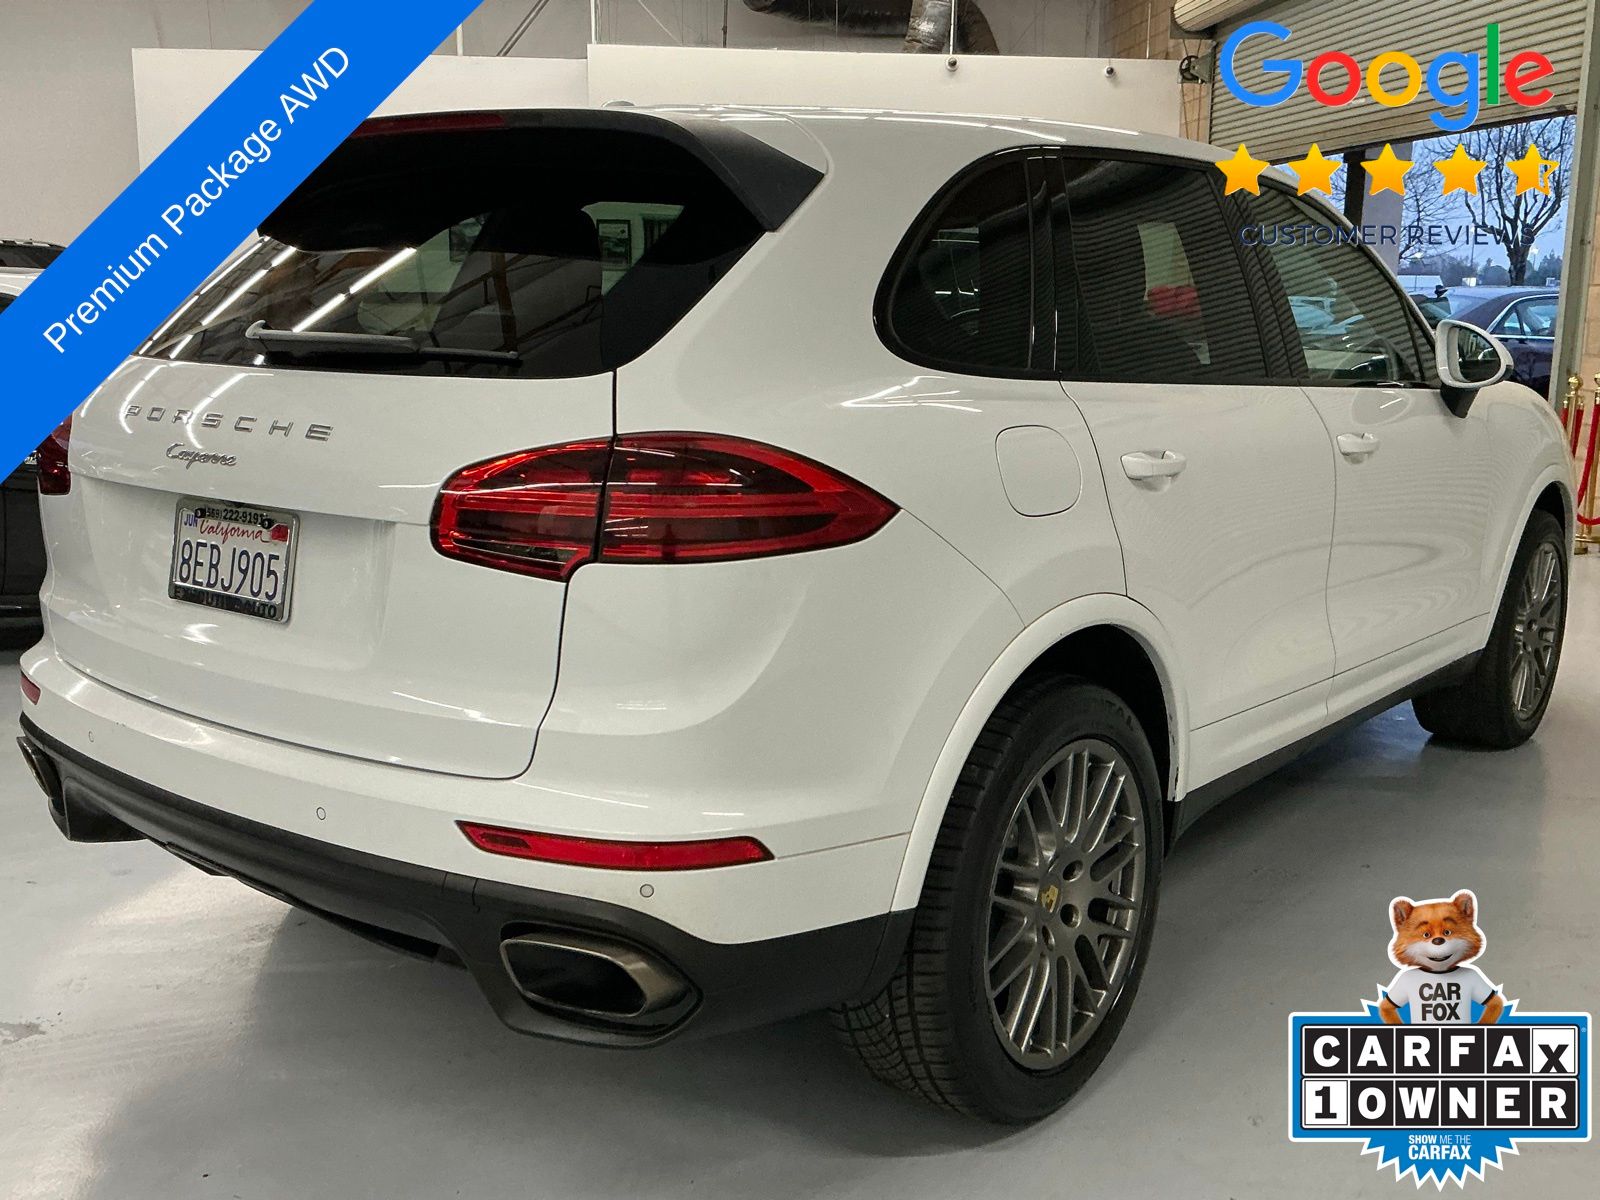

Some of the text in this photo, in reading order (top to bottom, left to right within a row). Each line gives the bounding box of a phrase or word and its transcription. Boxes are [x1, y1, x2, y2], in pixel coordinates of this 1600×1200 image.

[124, 405, 334, 441] PORSCHE
[166, 443, 238, 469] Cayenne
[200, 519, 271, 544] California
[178, 539, 281, 602] 8EBJ905
